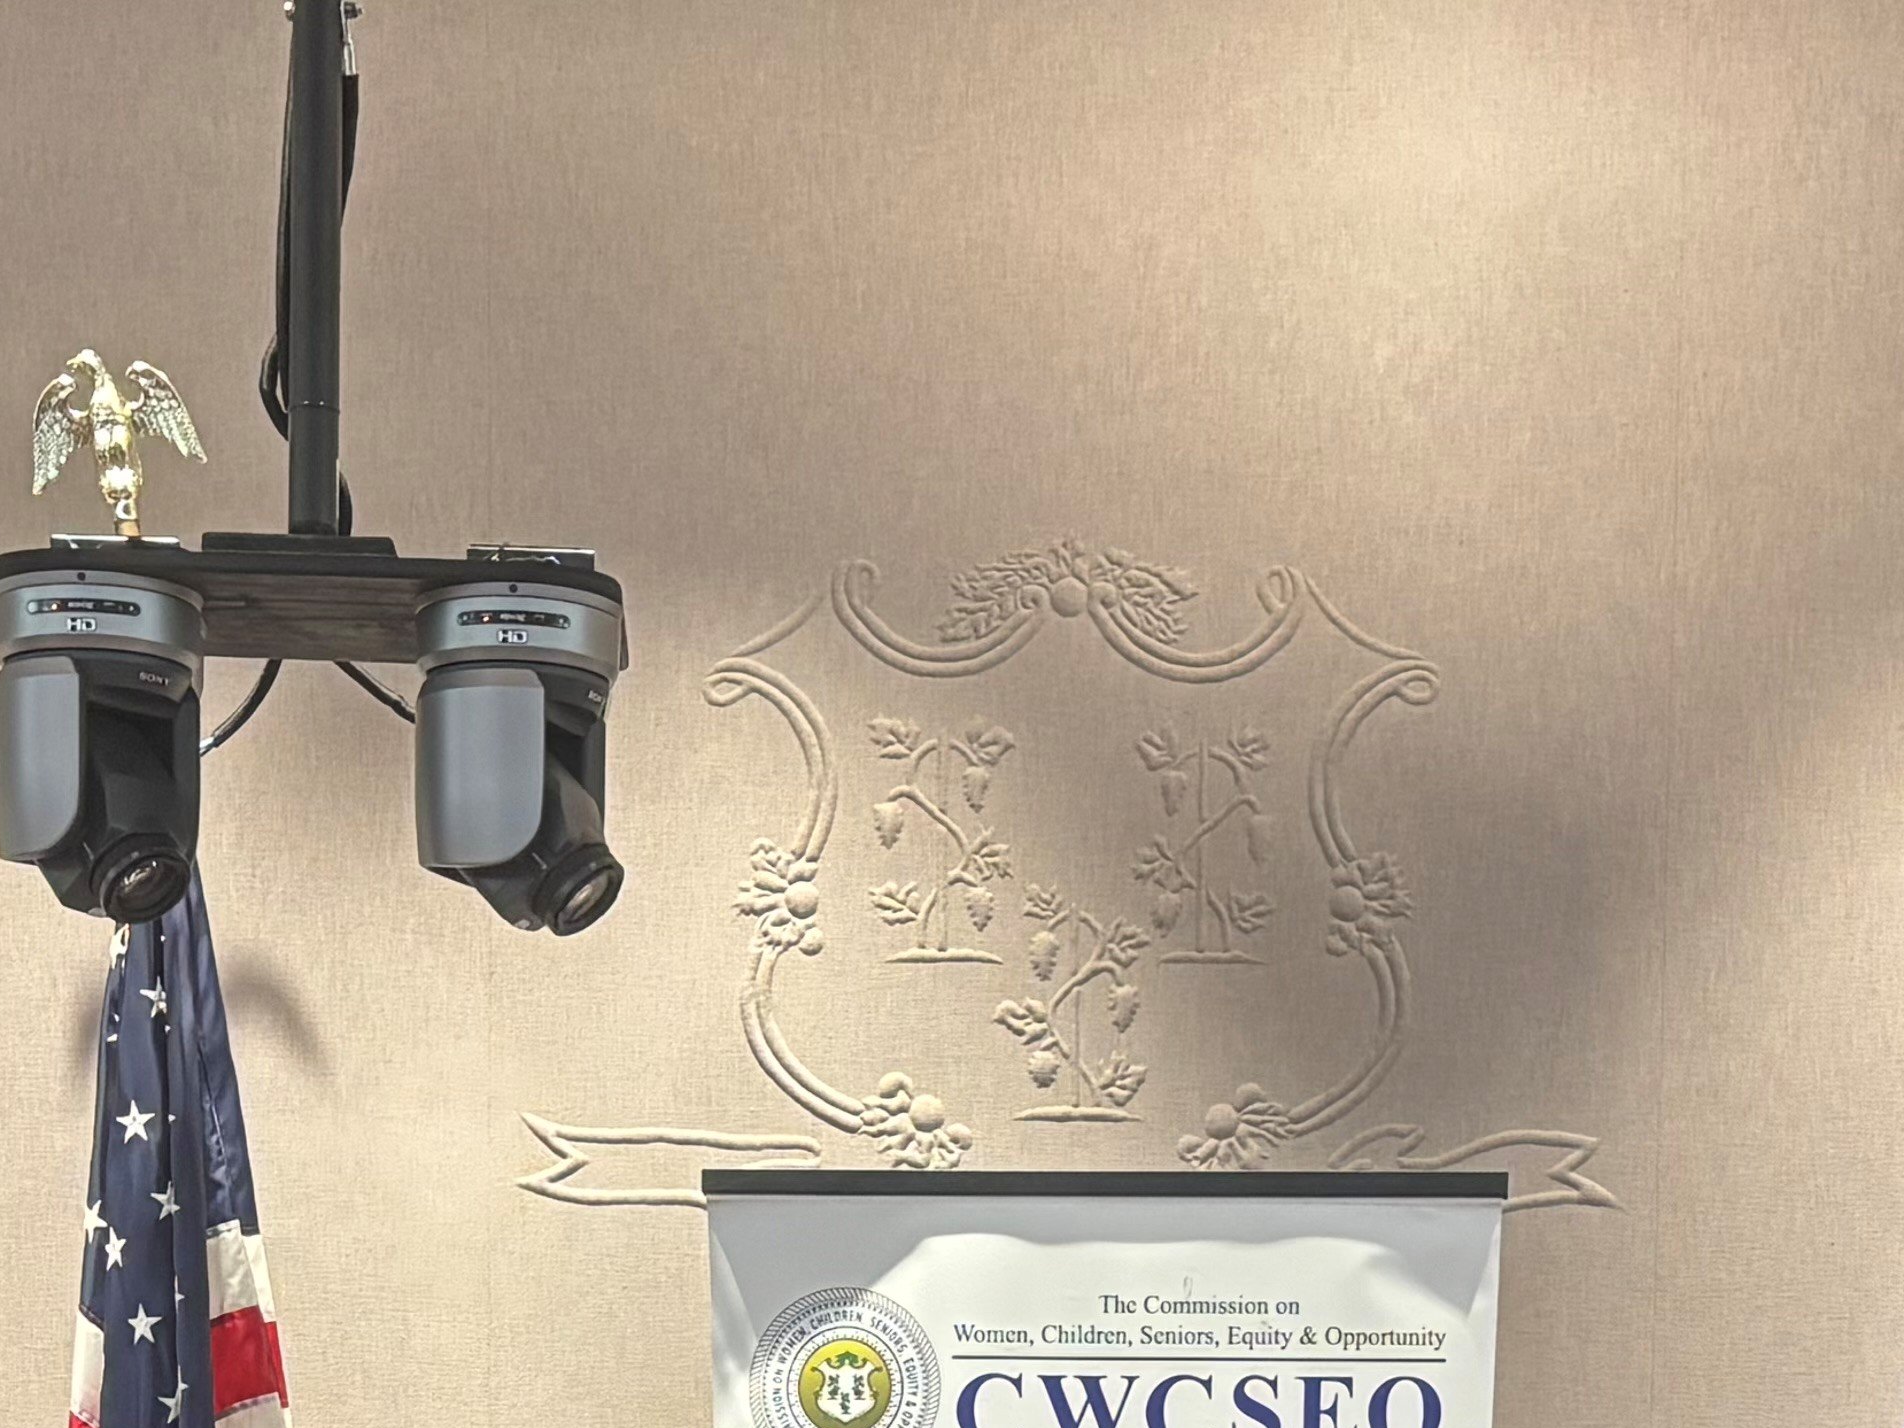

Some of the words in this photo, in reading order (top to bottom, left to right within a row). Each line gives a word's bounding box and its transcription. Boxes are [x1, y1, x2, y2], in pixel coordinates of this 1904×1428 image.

[66, 617, 97, 633] HD
[497, 629, 528, 644] HD
[1098, 1294, 1137, 1315] The
[1143, 1294, 1270, 1315] Commission
[1276, 1300, 1300, 1315] on
[953, 1324, 1035, 1346] Women,
[1041, 1324, 1134, 1347] Children,
[1139, 1325, 1220, 1348] Seniors,
[1227, 1325, 1294, 1350] Equity
[1298, 1325, 1318, 1346] &
[1324, 1326, 1447, 1351] Opportunity
